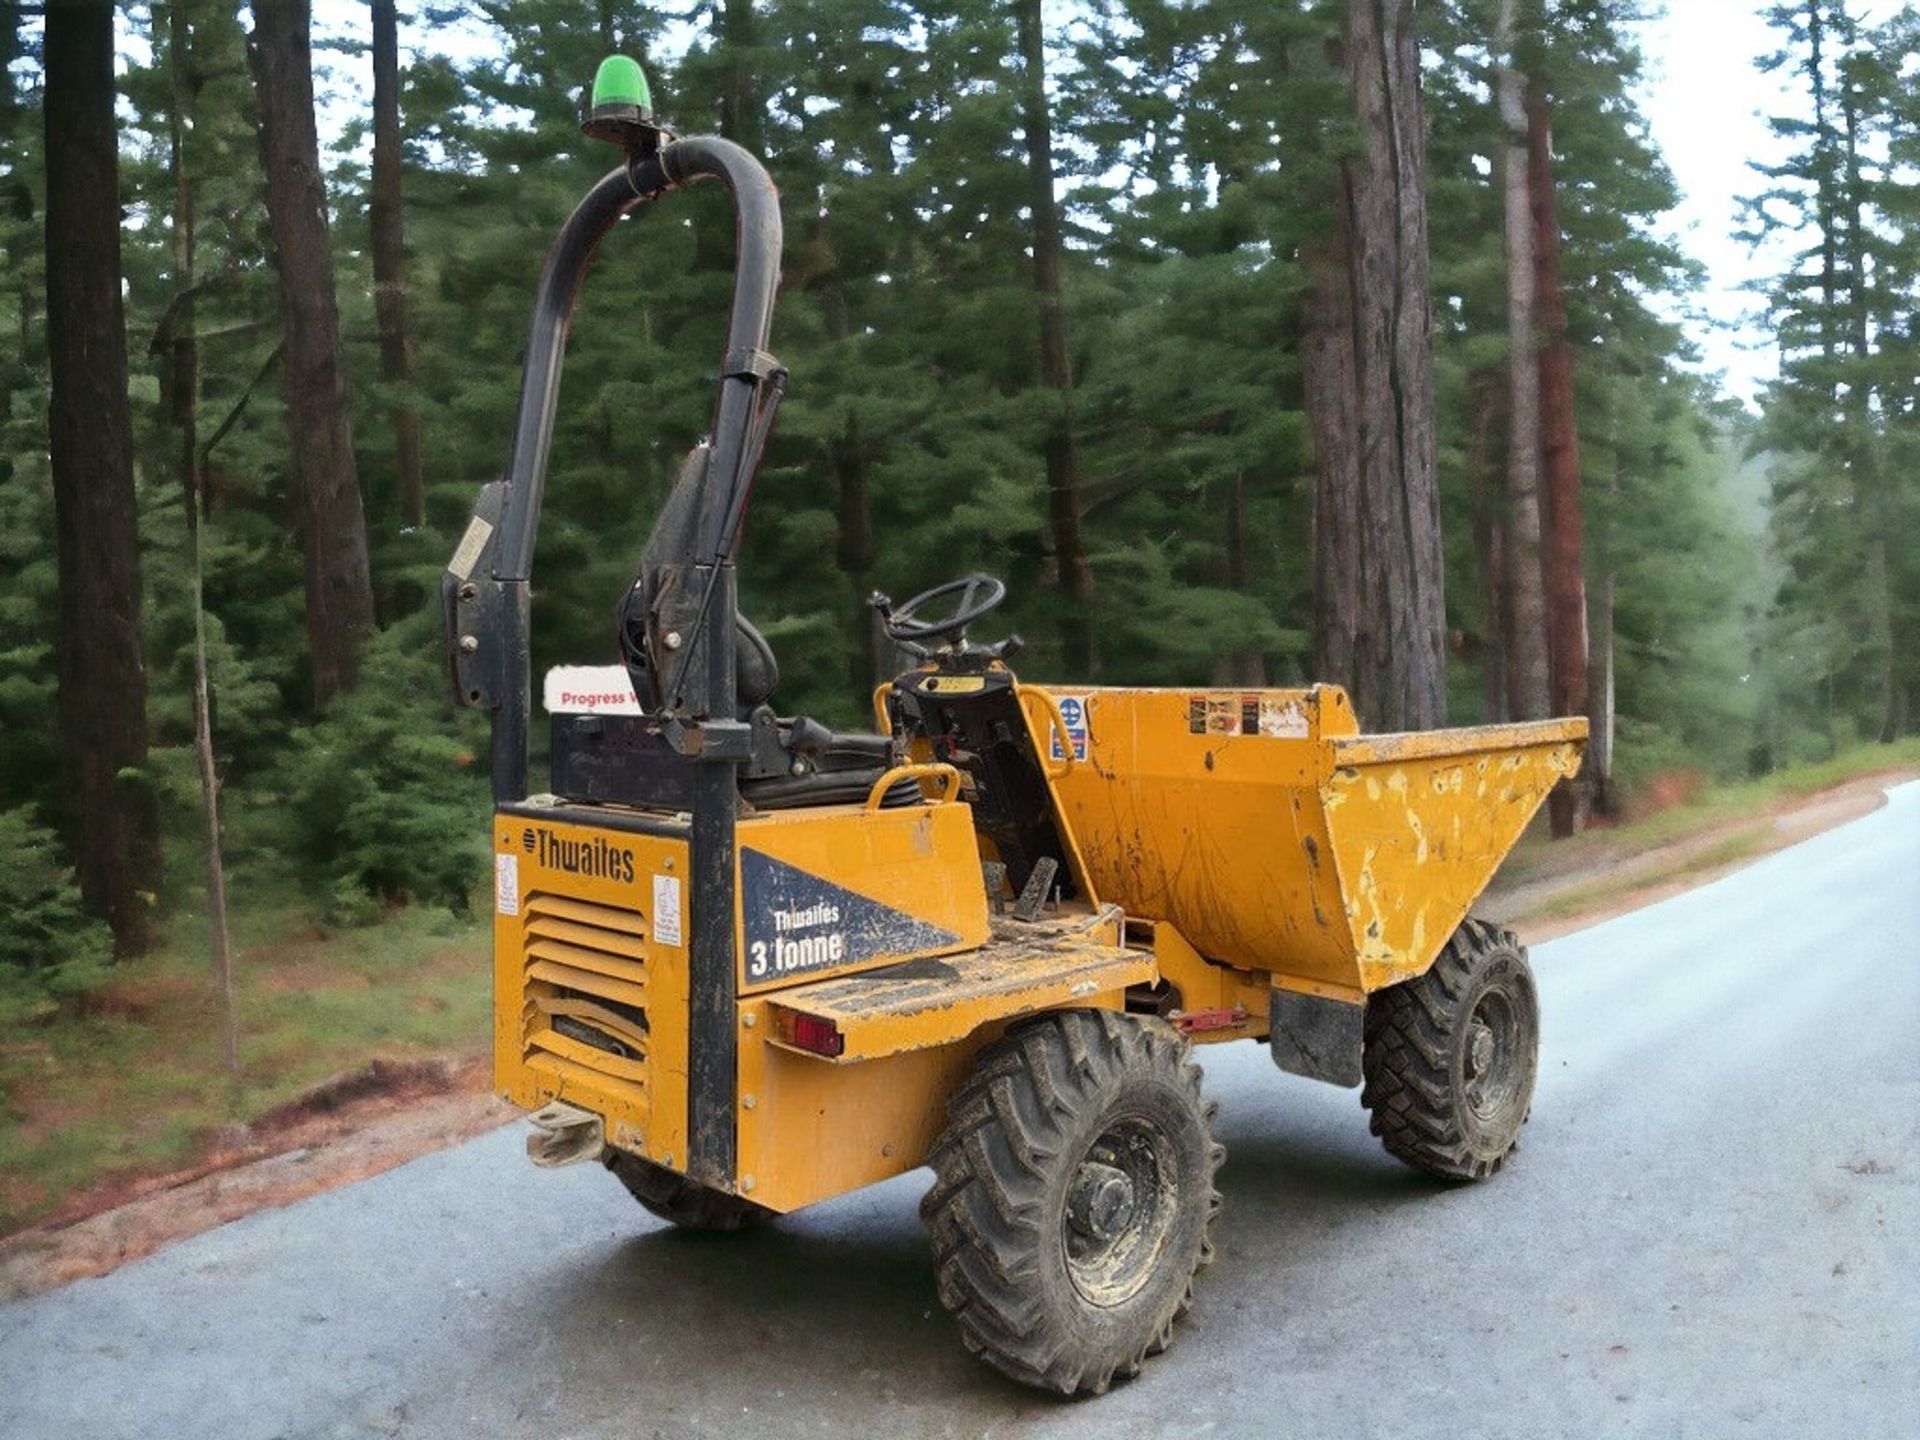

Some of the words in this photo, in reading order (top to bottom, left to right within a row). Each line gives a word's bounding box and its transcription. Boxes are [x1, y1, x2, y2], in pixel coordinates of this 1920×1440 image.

[561, 692, 625, 707] Progress
[537, 828, 635, 884] Thwaites
[774, 898, 840, 931] Thwaites
[751, 941, 768, 976] 3
[775, 934, 843, 971] tonne
